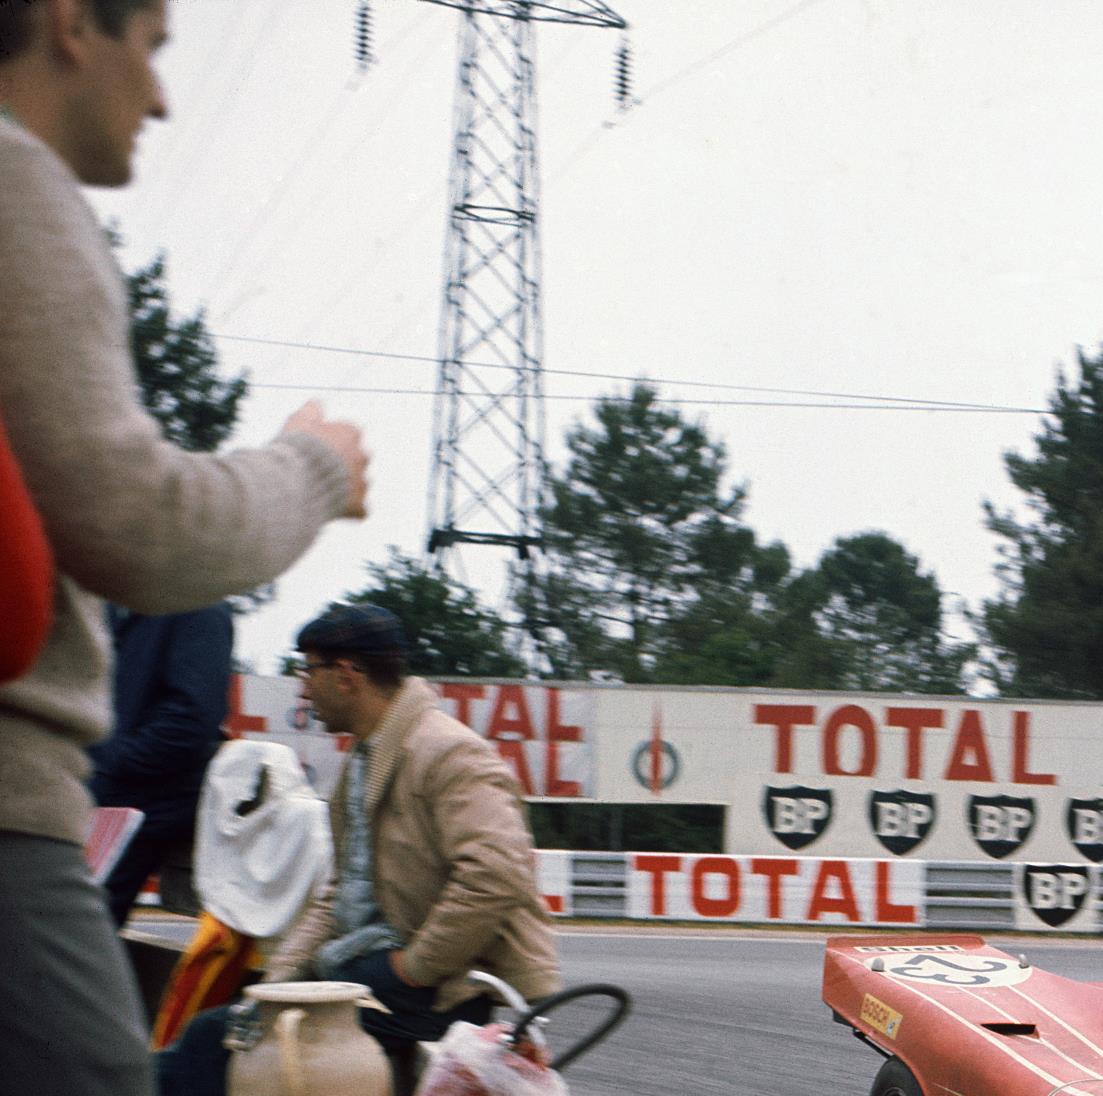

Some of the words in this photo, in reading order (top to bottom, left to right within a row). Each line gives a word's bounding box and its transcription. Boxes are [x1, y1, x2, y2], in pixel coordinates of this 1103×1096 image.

[440, 683, 584, 742] TAL
[753, 703, 1057, 786] TOTAL
[772, 797, 830, 835] BP
[876, 801, 933, 839] BP
[976, 805, 1033, 843] BP
[634, 855, 919, 924] TOTAL
[1028, 872, 1088, 911] BP
[890, 954, 1008, 985] 23
